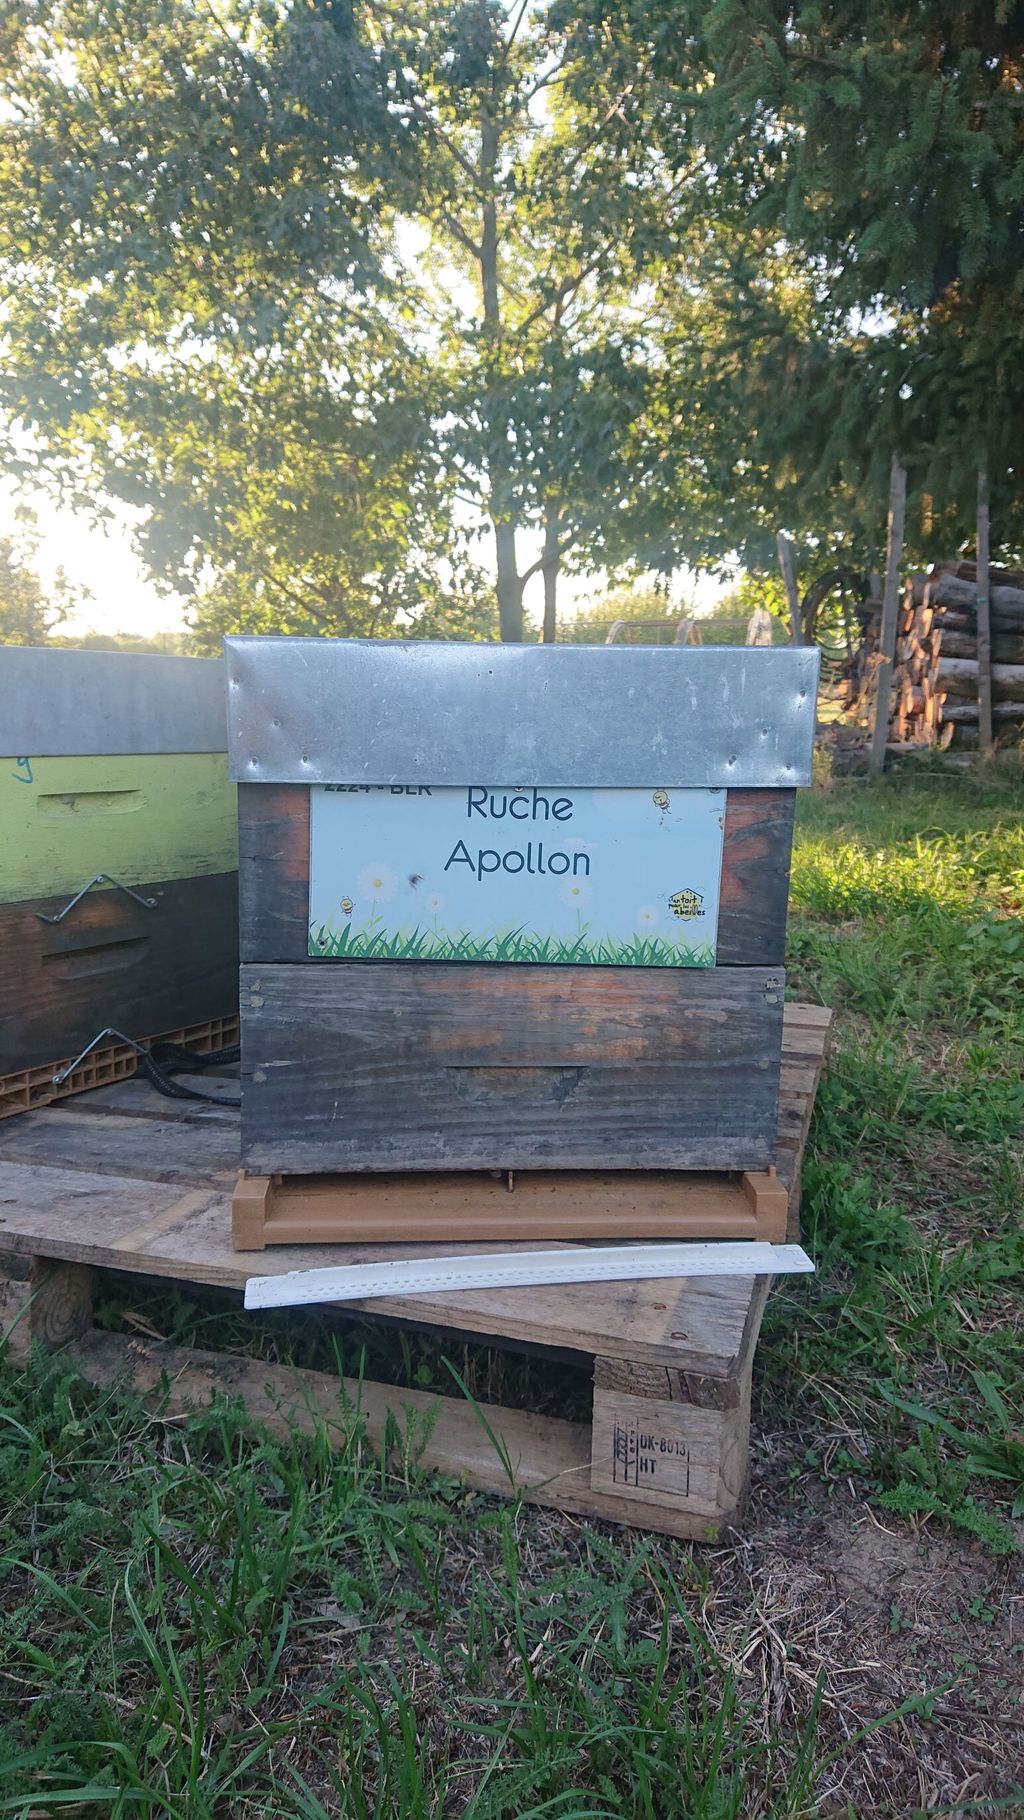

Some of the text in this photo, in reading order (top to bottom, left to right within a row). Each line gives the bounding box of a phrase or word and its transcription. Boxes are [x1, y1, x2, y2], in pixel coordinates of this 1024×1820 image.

[467, 786, 573, 821] Ruche
[444, 840, 590, 881] Apollon
[681, 894, 697, 904] toit
[640, 1456, 656, 1474] HT
